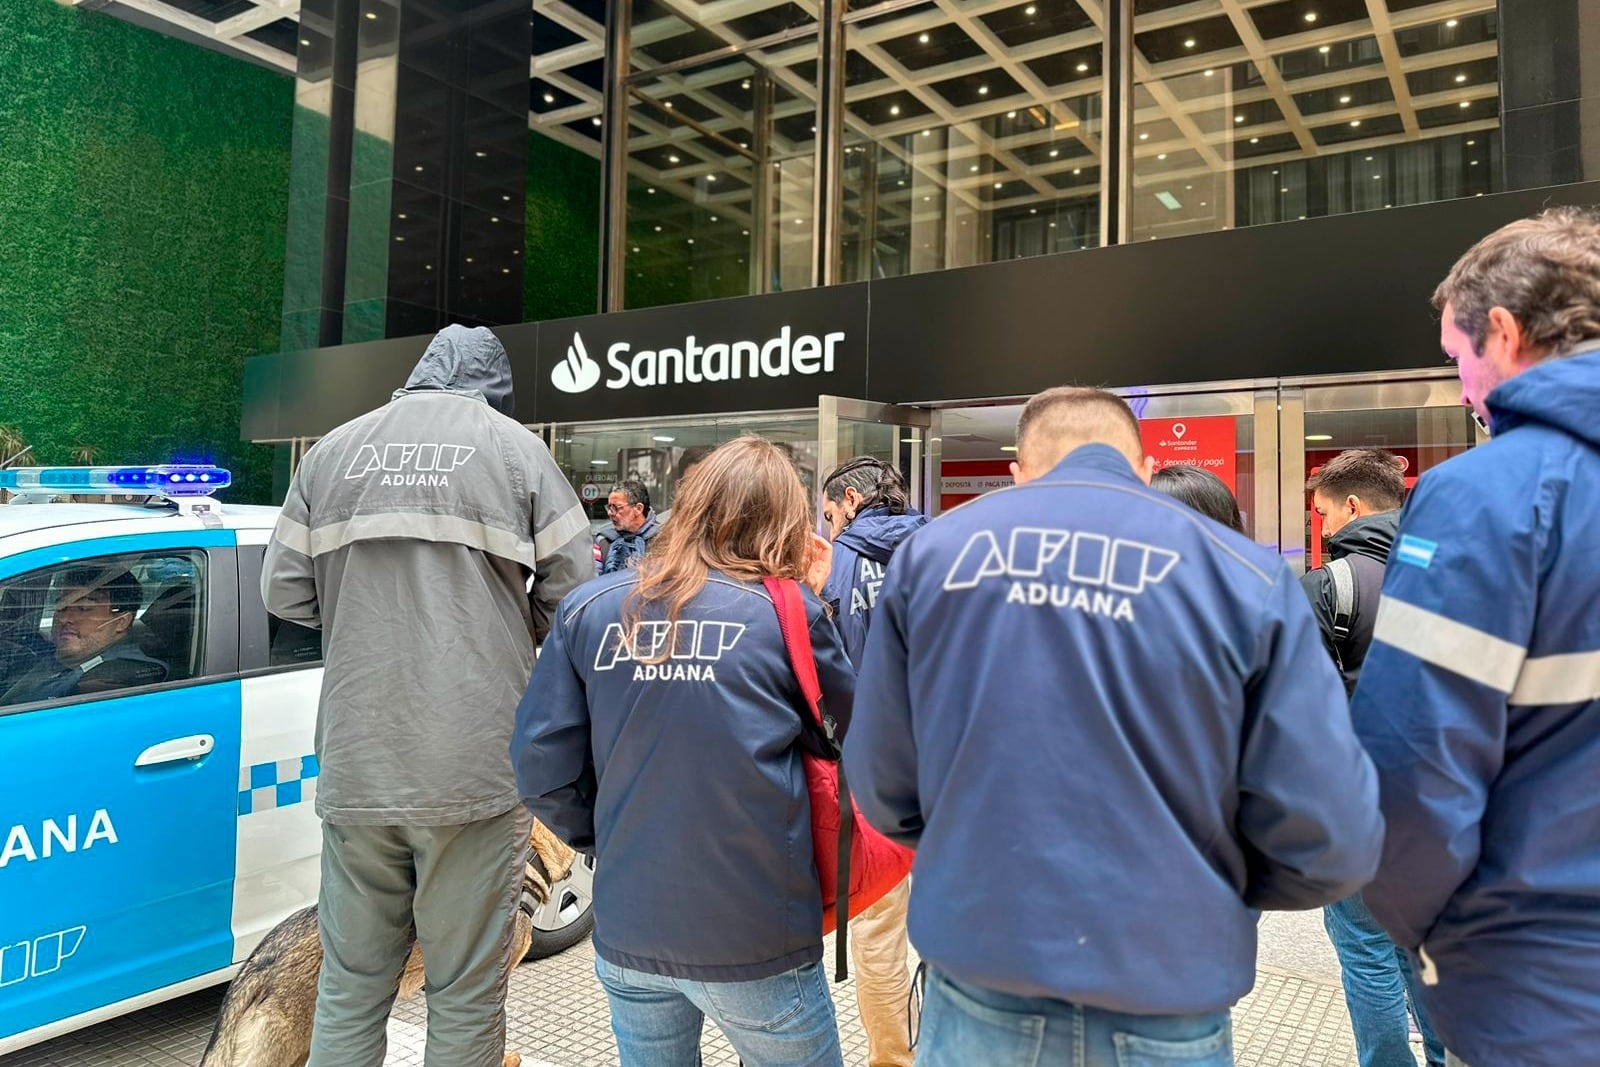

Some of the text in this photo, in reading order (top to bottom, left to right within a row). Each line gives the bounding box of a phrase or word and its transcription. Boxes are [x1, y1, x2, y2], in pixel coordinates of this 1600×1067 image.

[606, 325, 846, 390] Santander
[344, 443, 476, 480] AFIP
[380, 474, 449, 487] ADUANA
[1198, 459, 1204, 467] y
[943, 527, 1181, 593] AFIP
[1006, 582, 1135, 622] ADUANA
[594, 620, 746, 671] AFIP
[632, 664, 716, 682] ADUANA
[0, 808, 119, 867] ANA
